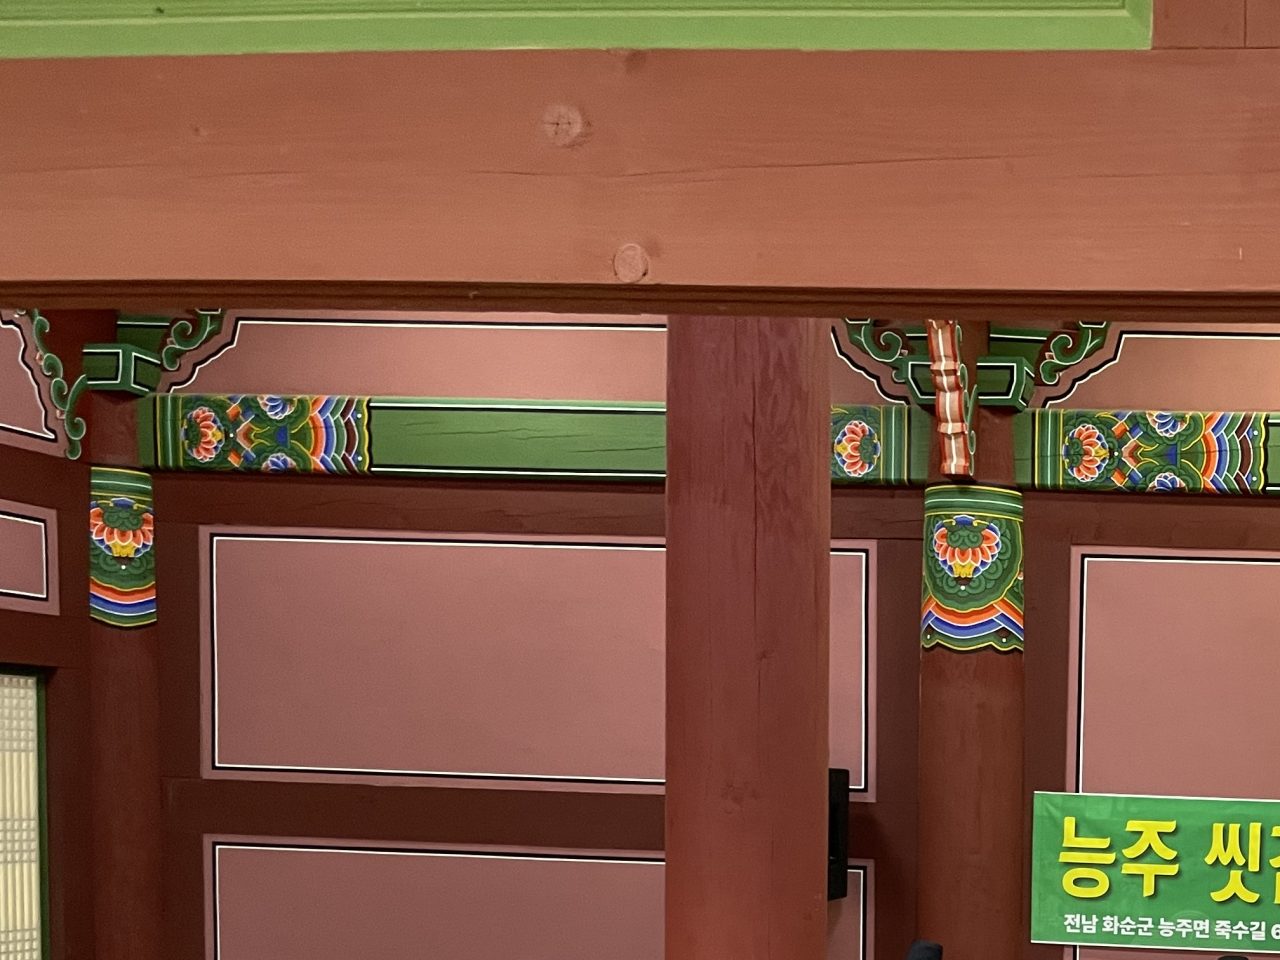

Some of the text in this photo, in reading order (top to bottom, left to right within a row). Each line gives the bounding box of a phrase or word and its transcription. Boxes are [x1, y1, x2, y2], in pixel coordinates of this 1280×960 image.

[1058, 816, 1180, 899] 능주
[1063, 913, 1099, 934] 전남
[1101, 915, 1155, 937] 화순군
[1157, 917, 1210, 939] 능주면
[1214, 920, 1266, 941] 죽수길
